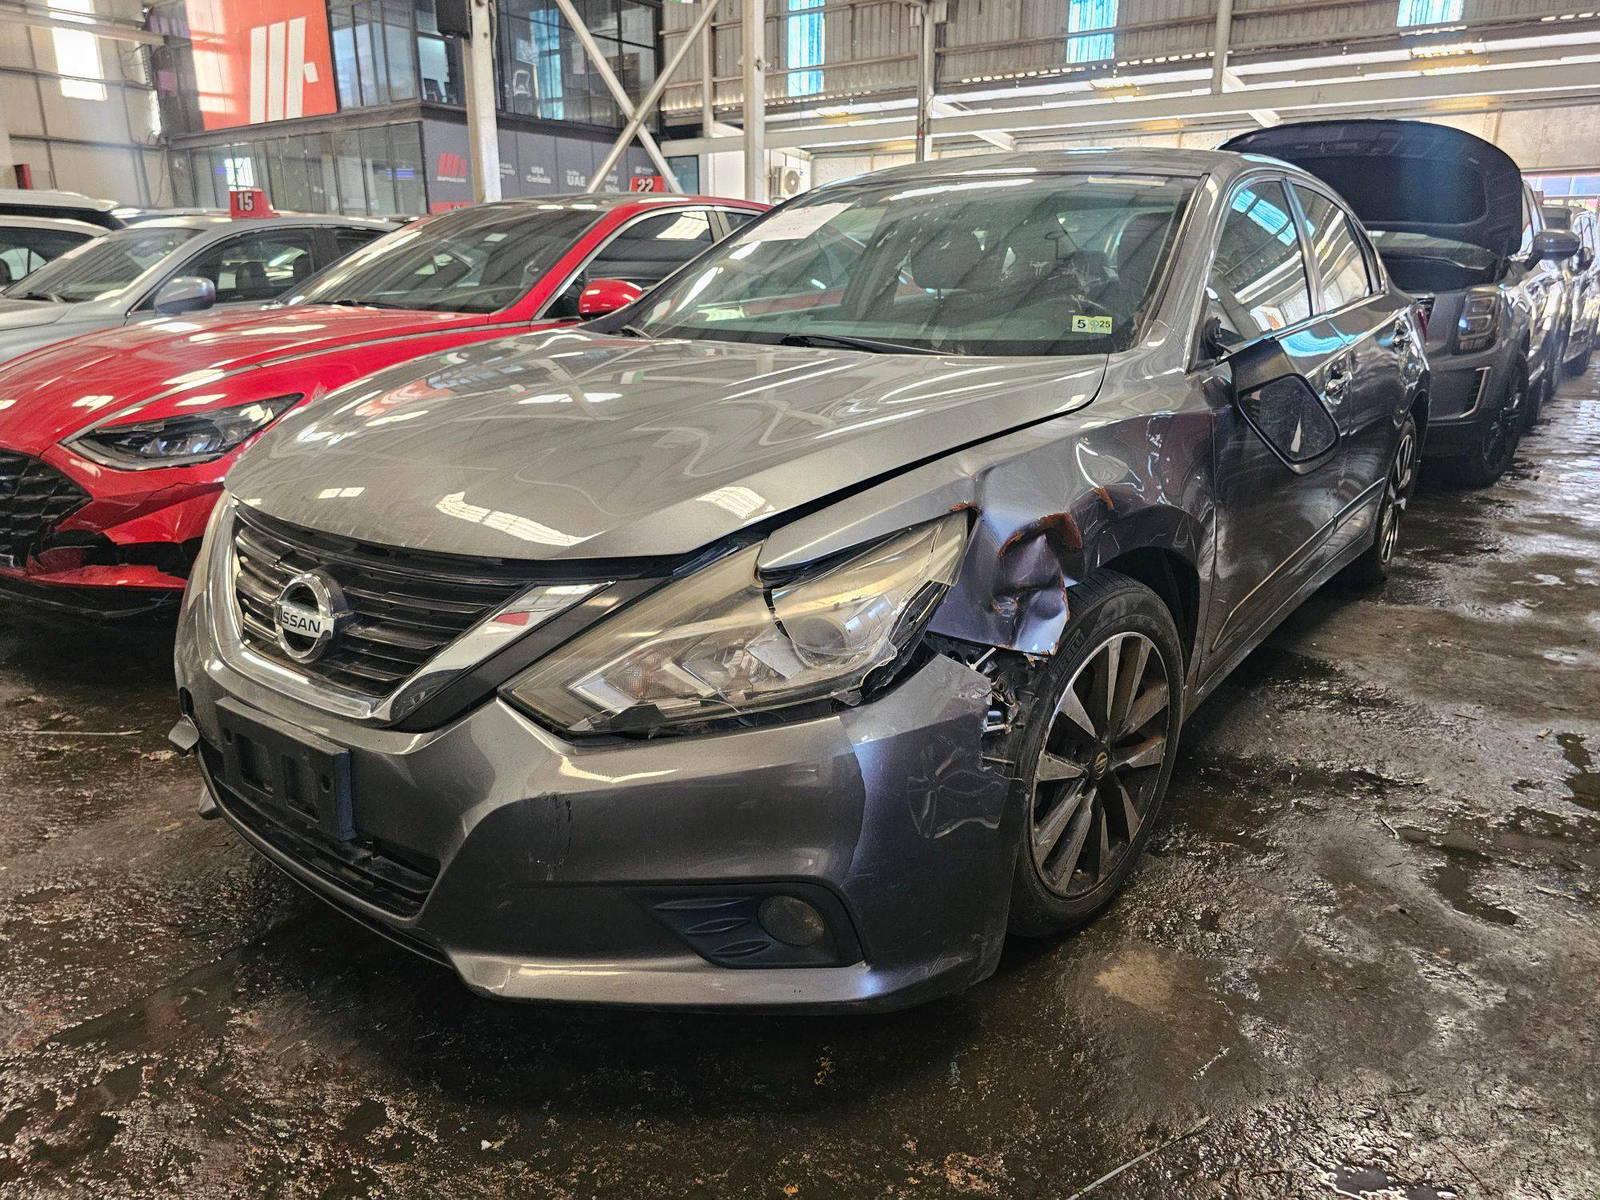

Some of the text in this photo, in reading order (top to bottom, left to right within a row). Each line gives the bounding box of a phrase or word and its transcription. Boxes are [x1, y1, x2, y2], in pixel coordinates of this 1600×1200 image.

[567, 175, 586, 187] UAE
[637, 178, 654, 192] 22
[238, 191, 253, 211] 15
[1077, 319, 1111, 328] 5 25
[280, 609, 321, 633] ISSAN
